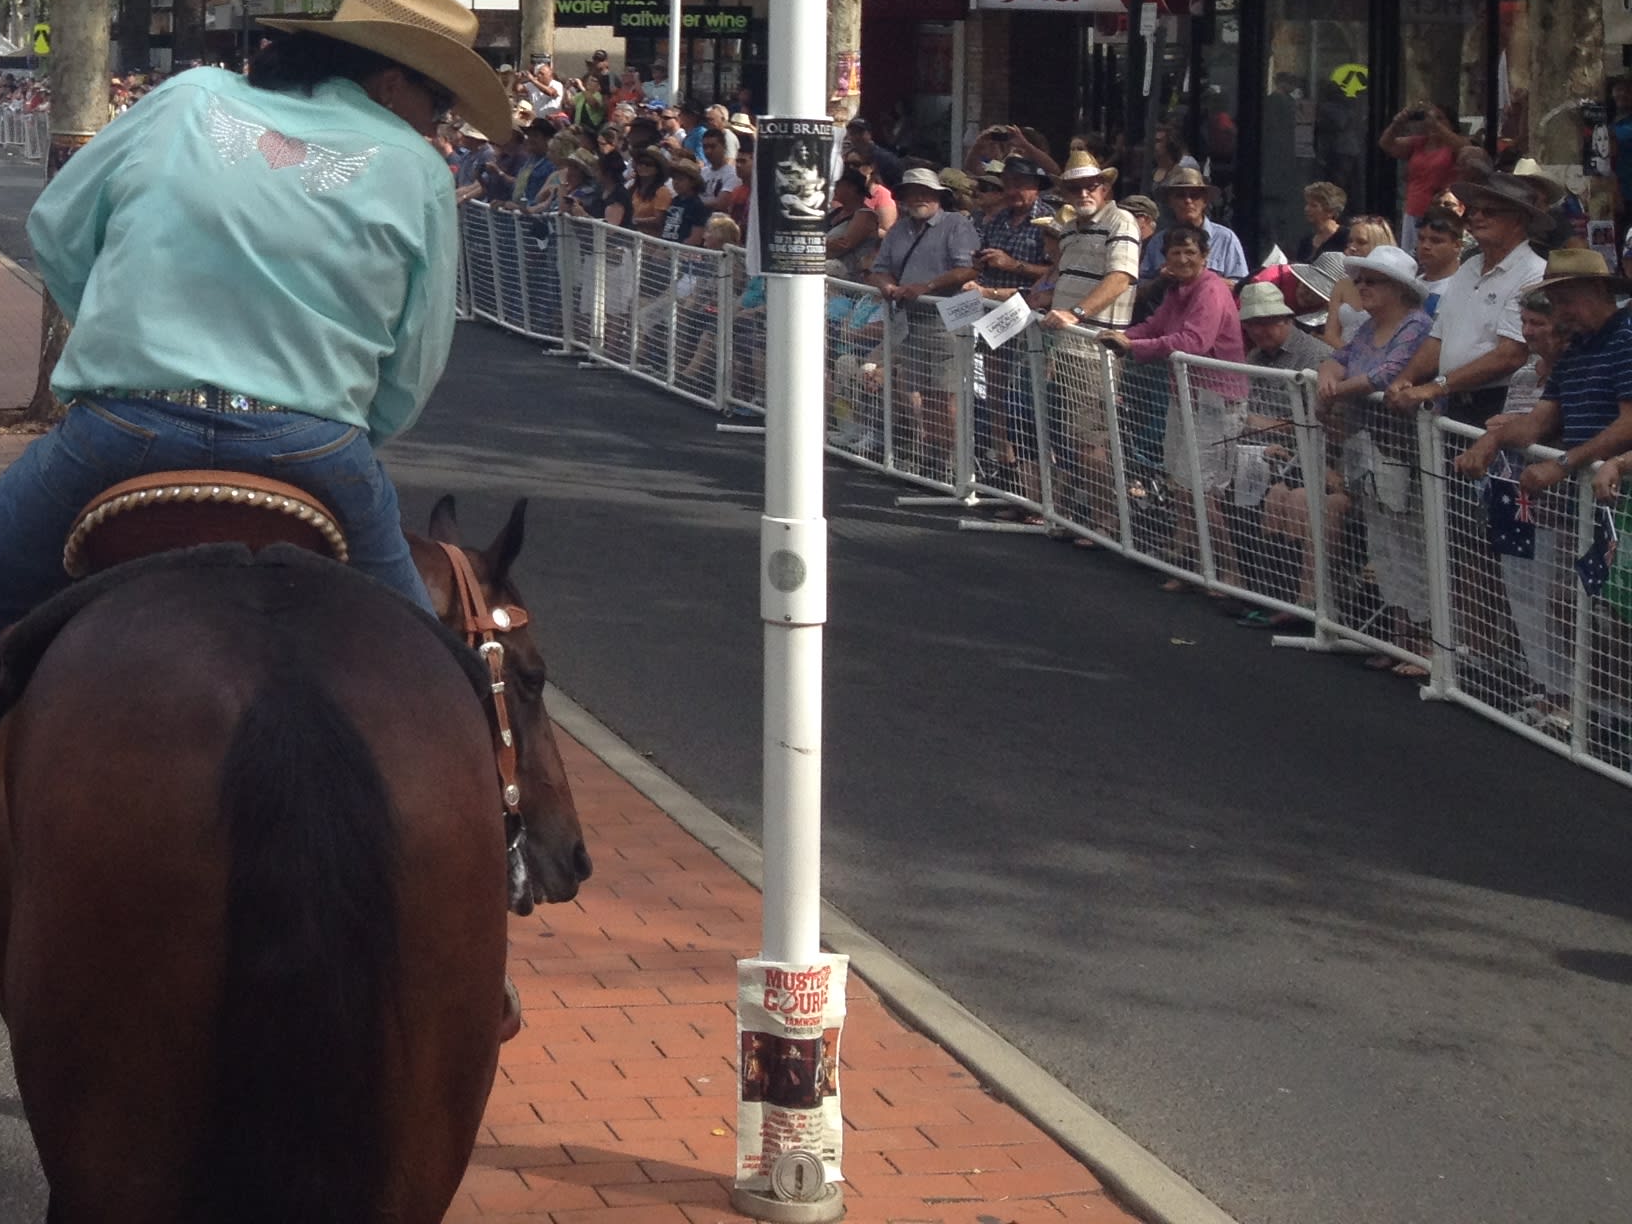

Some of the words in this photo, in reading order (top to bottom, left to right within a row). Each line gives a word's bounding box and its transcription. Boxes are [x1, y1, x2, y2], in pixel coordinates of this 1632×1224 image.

[620, 10, 701, 27] saltwaer
[705, 12, 747, 28] wine
[760, 122, 788, 134] LOU
